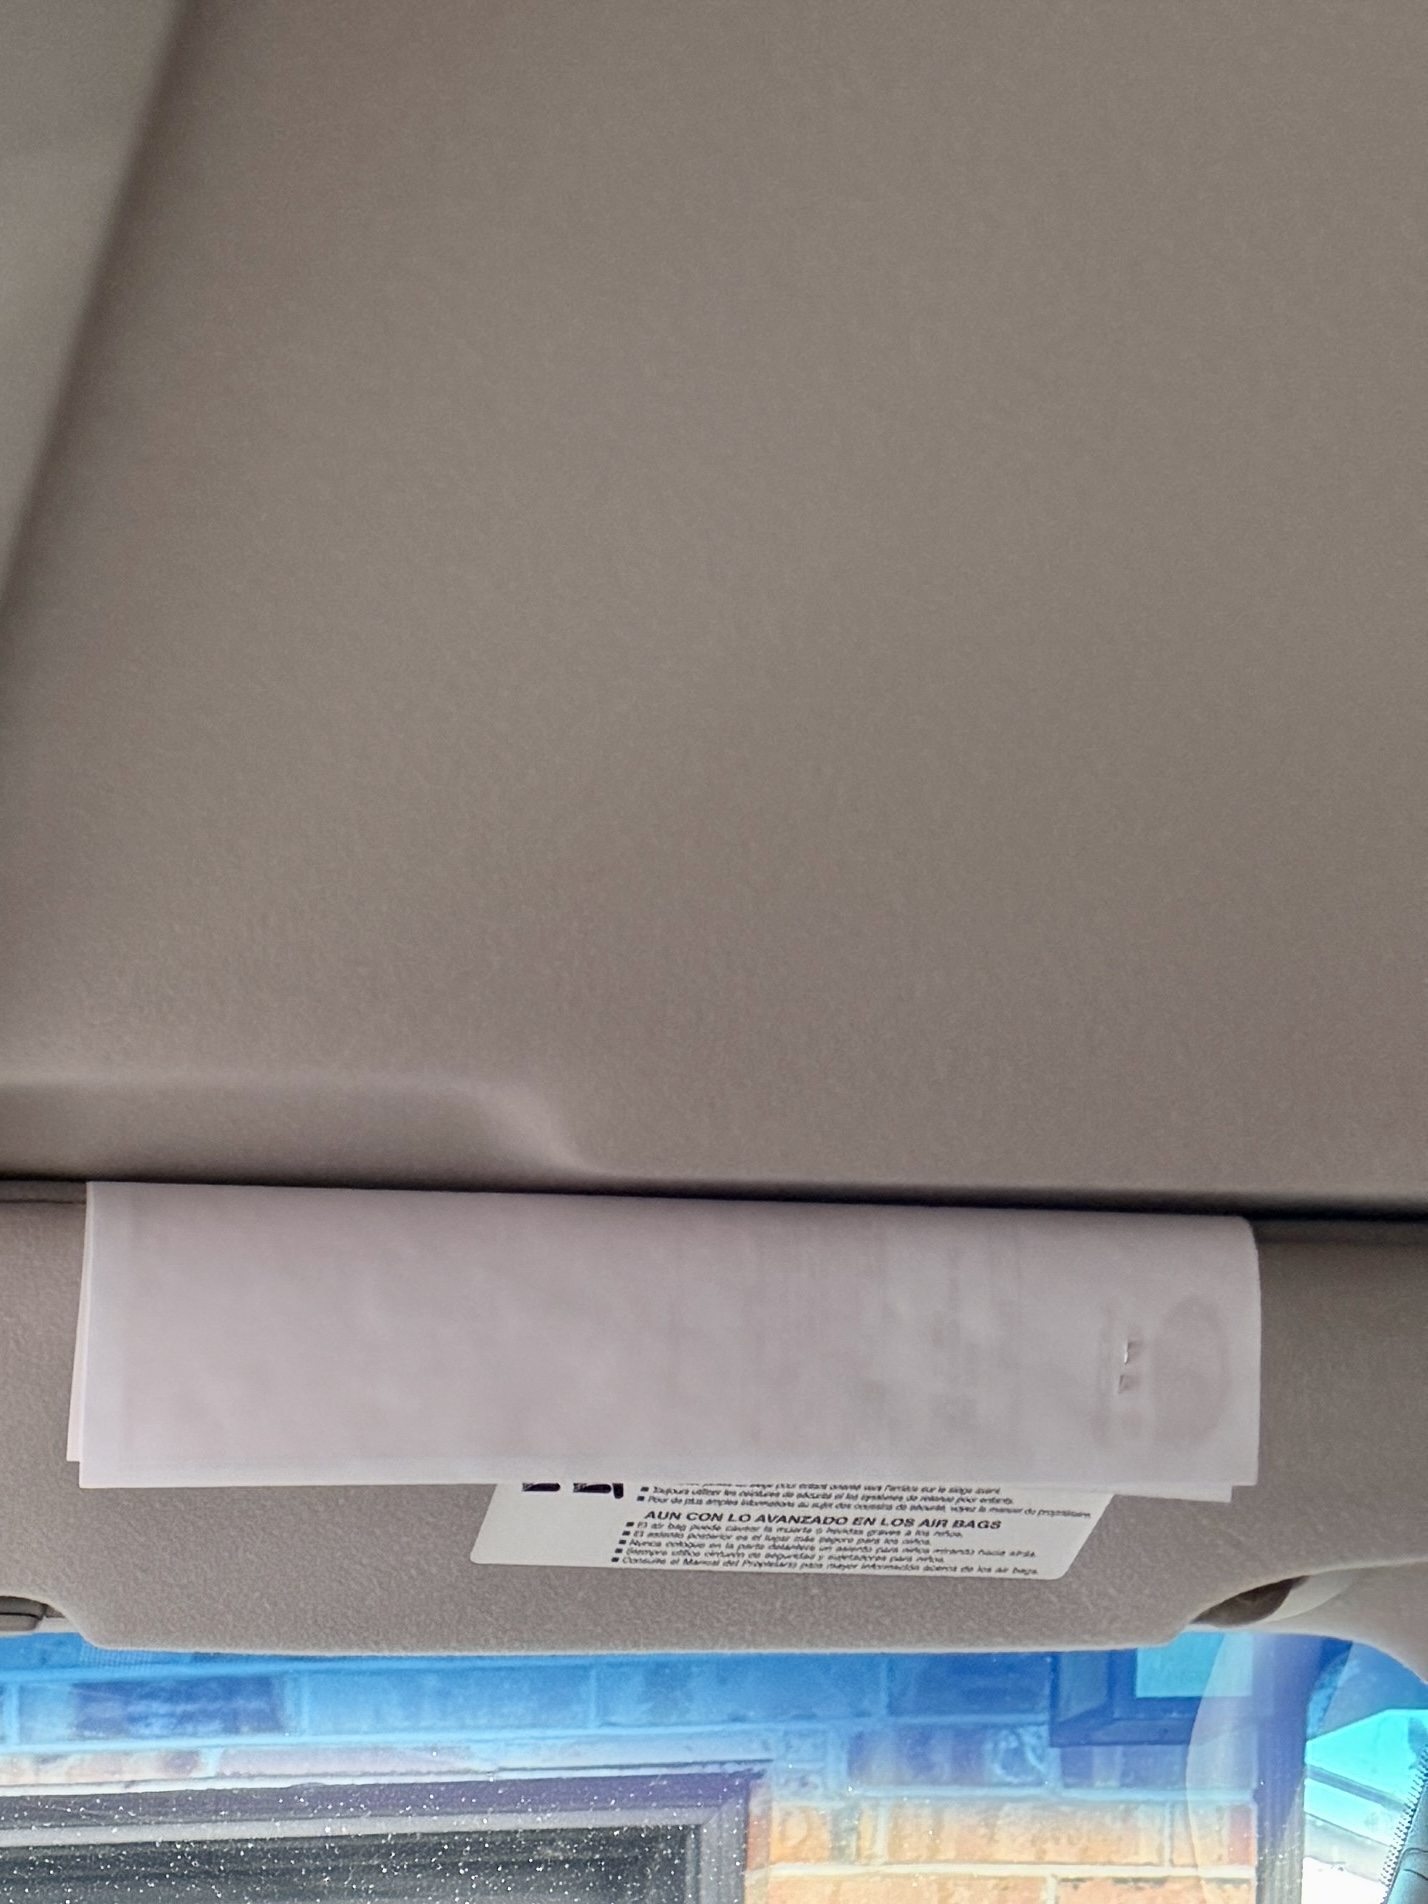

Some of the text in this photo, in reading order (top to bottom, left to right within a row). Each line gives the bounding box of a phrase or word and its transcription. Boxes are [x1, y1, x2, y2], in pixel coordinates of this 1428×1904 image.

[644, 1511, 1002, 1529] AUN CON LO AVANZADO EN LOS AIR BAGS
